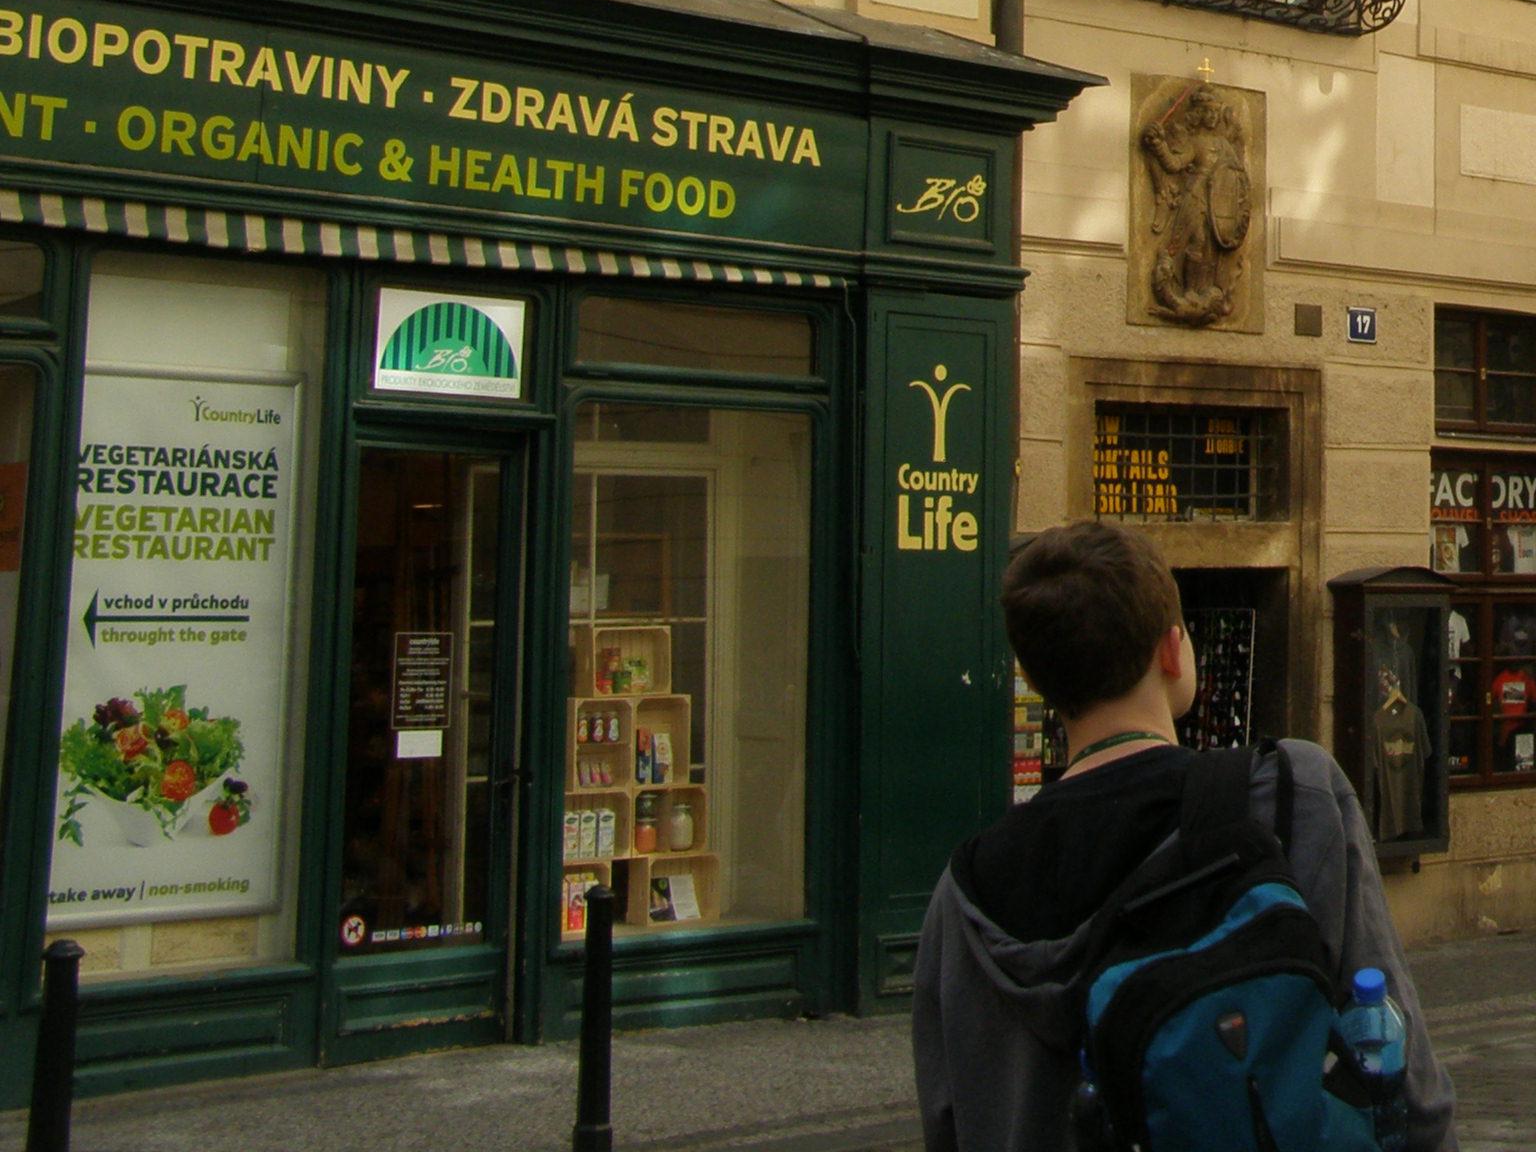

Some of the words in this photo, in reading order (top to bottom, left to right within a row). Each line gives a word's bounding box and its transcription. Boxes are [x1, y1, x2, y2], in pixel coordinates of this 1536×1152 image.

[0, 10, 410, 108] BIOPOTRAVINY
[449, 76, 640, 143] ZDRAVÁ
[652, 107, 821, 167] STRAVA
[117, 106, 363, 176] ORGANIC
[378, 139, 413, 182] &
[428, 145, 605, 205] HEALTH
[619, 170, 737, 219] FOOD
[1356, 314, 1371, 335] 17
[78, 444, 279, 471] VEGETARIÁNSKÁ
[77, 468, 278, 498] RESTAURACE
[898, 463, 979, 494] Country
[75, 504, 275, 534] VEGETARIAN
[898, 494, 978, 551] Life
[74, 534, 275, 561] RESTAURANT
[104, 594, 154, 609] vchod
[159, 598, 168, 609] v
[172, 593, 249, 612] průchodu
[102, 627, 175, 645] throught
[179, 627, 207, 642] the
[210, 629, 247, 645] gate
[50, 888, 88, 904] take
[91, 886, 136, 902] away
[149, 877, 250, 896] non-smoking
